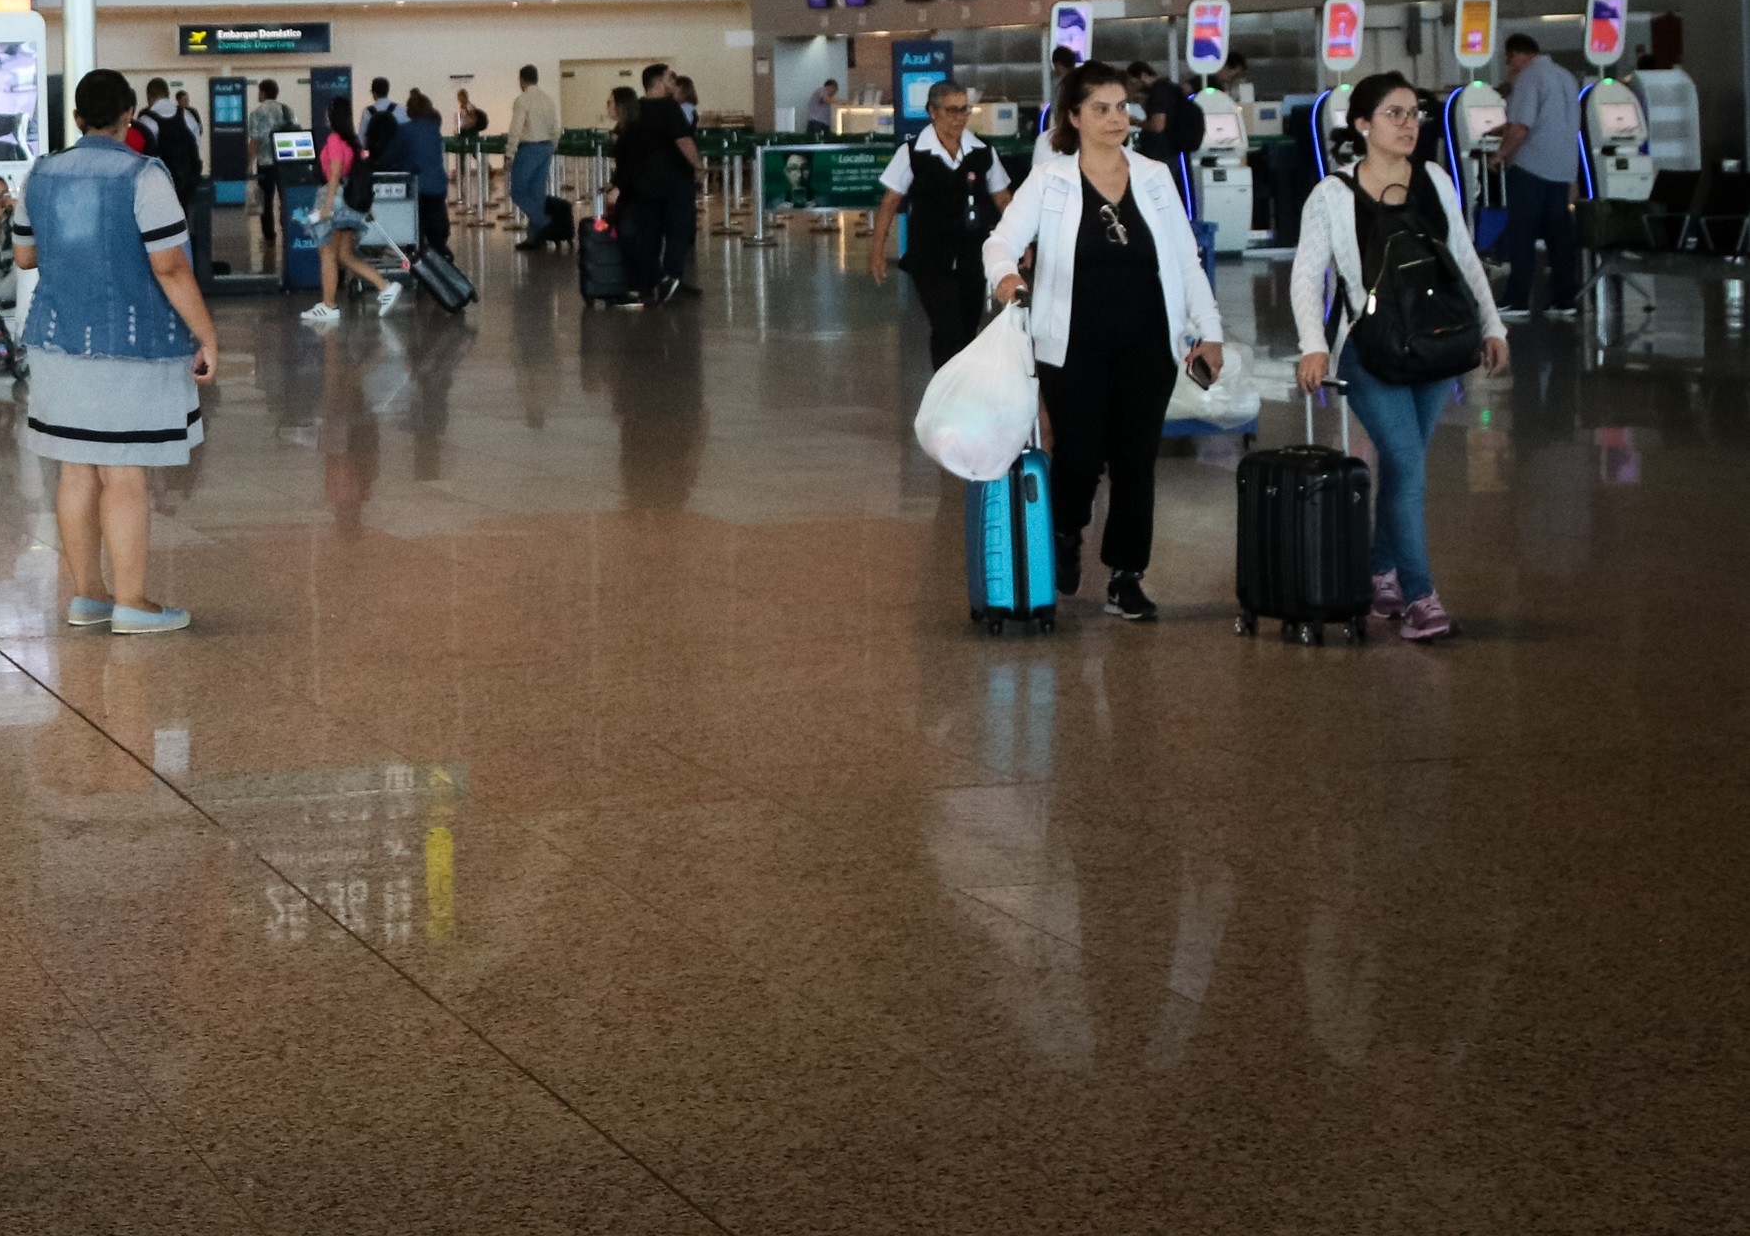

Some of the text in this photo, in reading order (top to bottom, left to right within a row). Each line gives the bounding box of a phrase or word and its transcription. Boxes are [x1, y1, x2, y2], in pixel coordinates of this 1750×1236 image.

[217, 28, 302, 40] Embarque Doméstico
[902, 52, 931, 65] Azul
